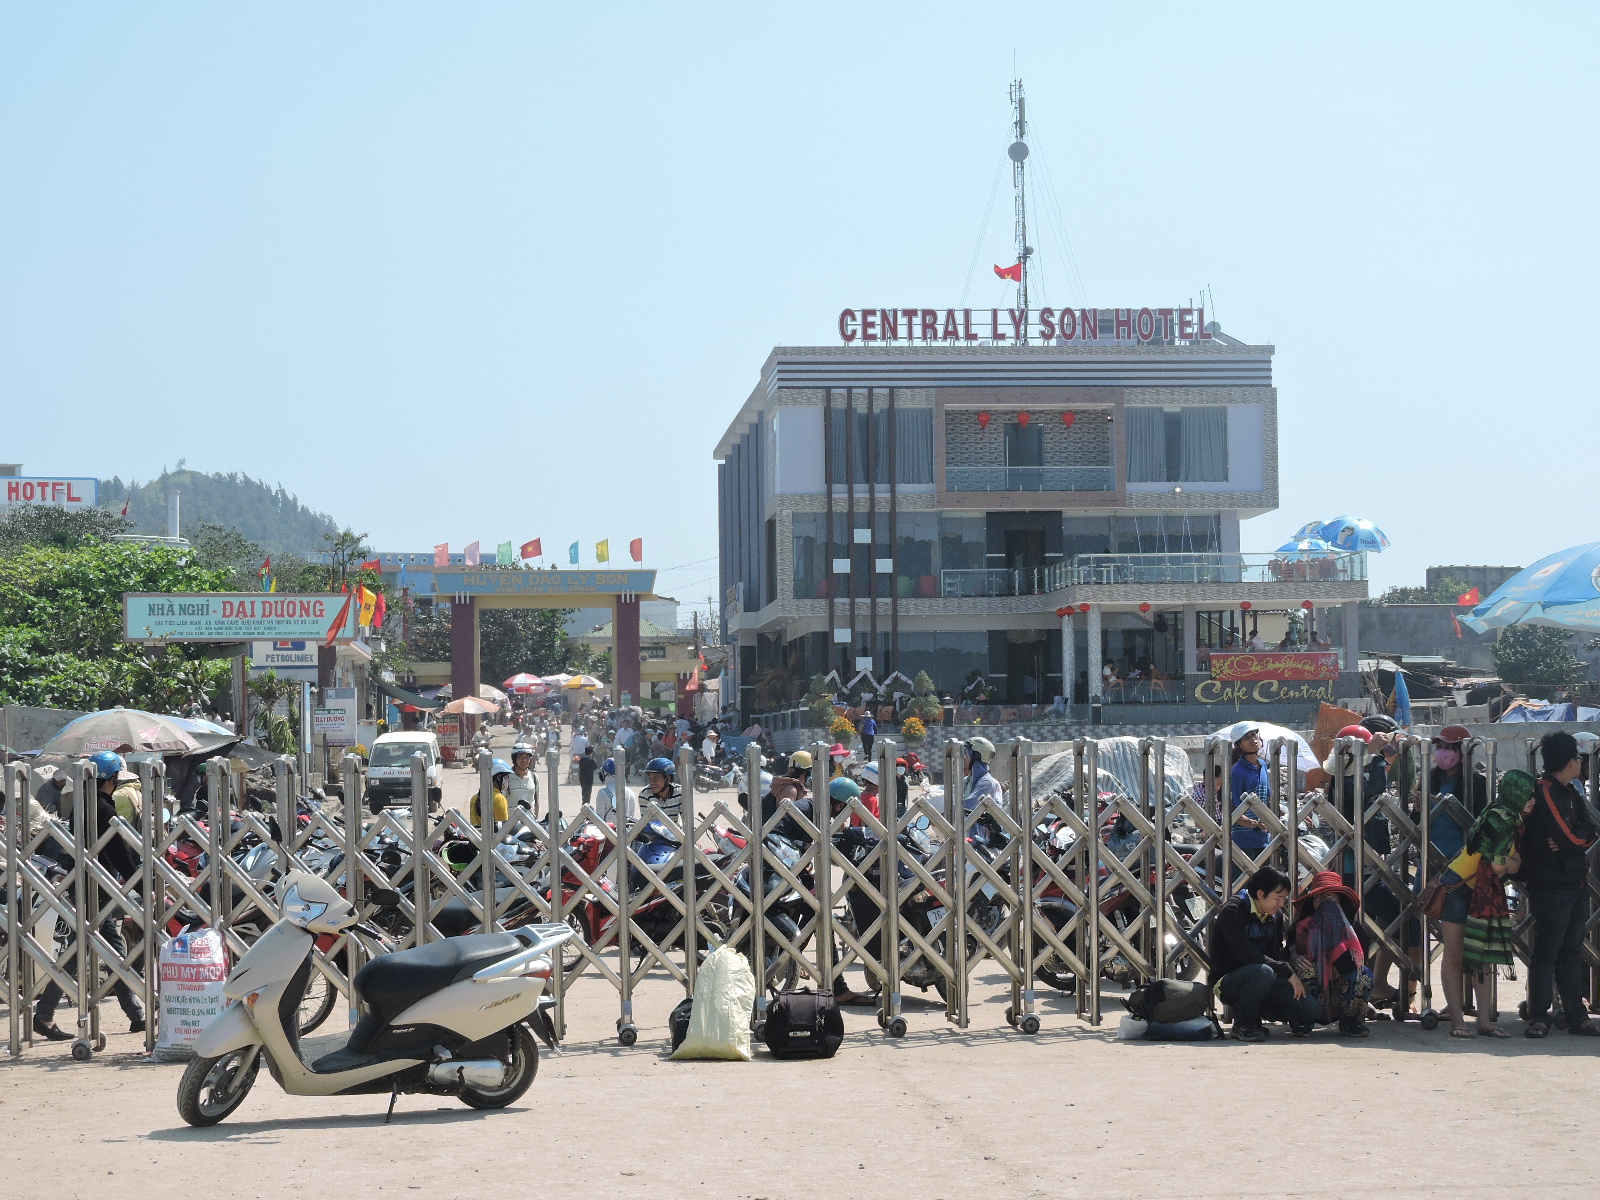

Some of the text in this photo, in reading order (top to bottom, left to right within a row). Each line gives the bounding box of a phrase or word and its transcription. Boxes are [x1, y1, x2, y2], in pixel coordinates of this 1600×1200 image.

[838, 307, 1213, 342] CENTRAL LY SON HOTEL
[148, 599, 175, 616] NHÀ
[222, 601, 256, 620] ĐẠI
[1194, 679, 1336, 712] Cafe Central
[162, 965, 222, 980] PHU MY MOP
[177, 983, 205, 992] STANDARD
[192, 1008, 205, 1016] 0.5%
[206, 1007, 216, 1016] MAX
[184, 1027, 191, 1035] NO
